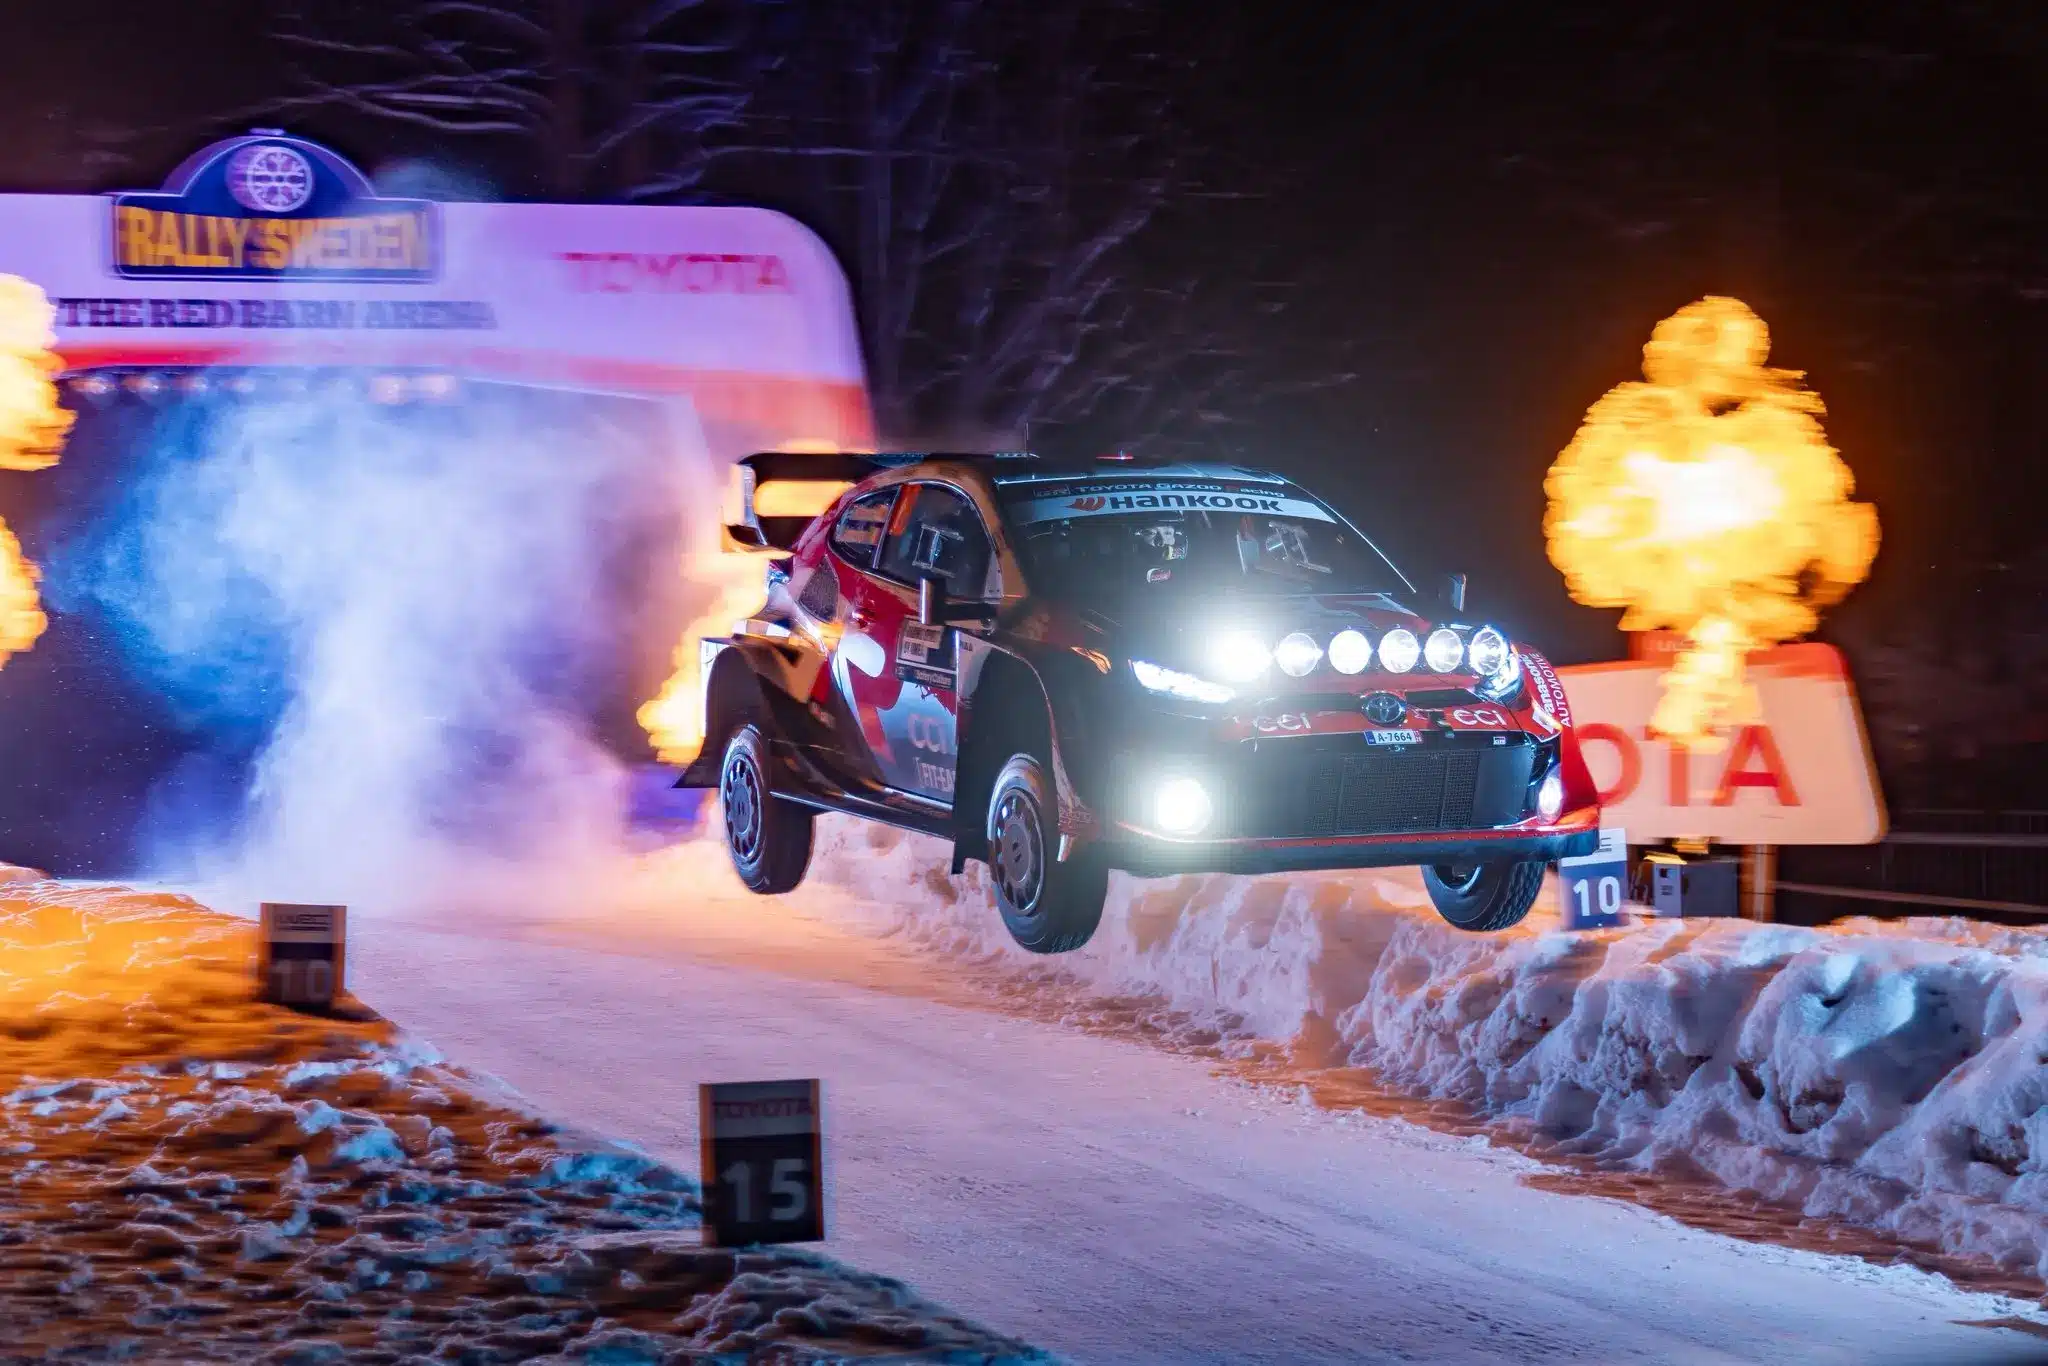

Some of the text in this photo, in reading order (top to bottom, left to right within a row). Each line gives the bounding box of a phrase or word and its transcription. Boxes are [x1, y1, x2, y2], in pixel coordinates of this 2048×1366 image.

[120, 205, 432, 270] RALLY SWEDEN
[556, 251, 794, 294] TOYOTA
[59, 298, 143, 327] THE
[149, 299, 234, 328] RED
[239, 300, 357, 329] BARN
[1075, 483, 1151, 493] TOYOTA
[1154, 483, 1222, 491] GAZOO
[1529, 652, 1571, 728] AUTOMOTIVE
[1377, 733, 1412, 742] A-7664
[1572, 875, 1621, 917] 10
[271, 959, 332, 1002] 10
[721, 1158, 808, 1222] 15
